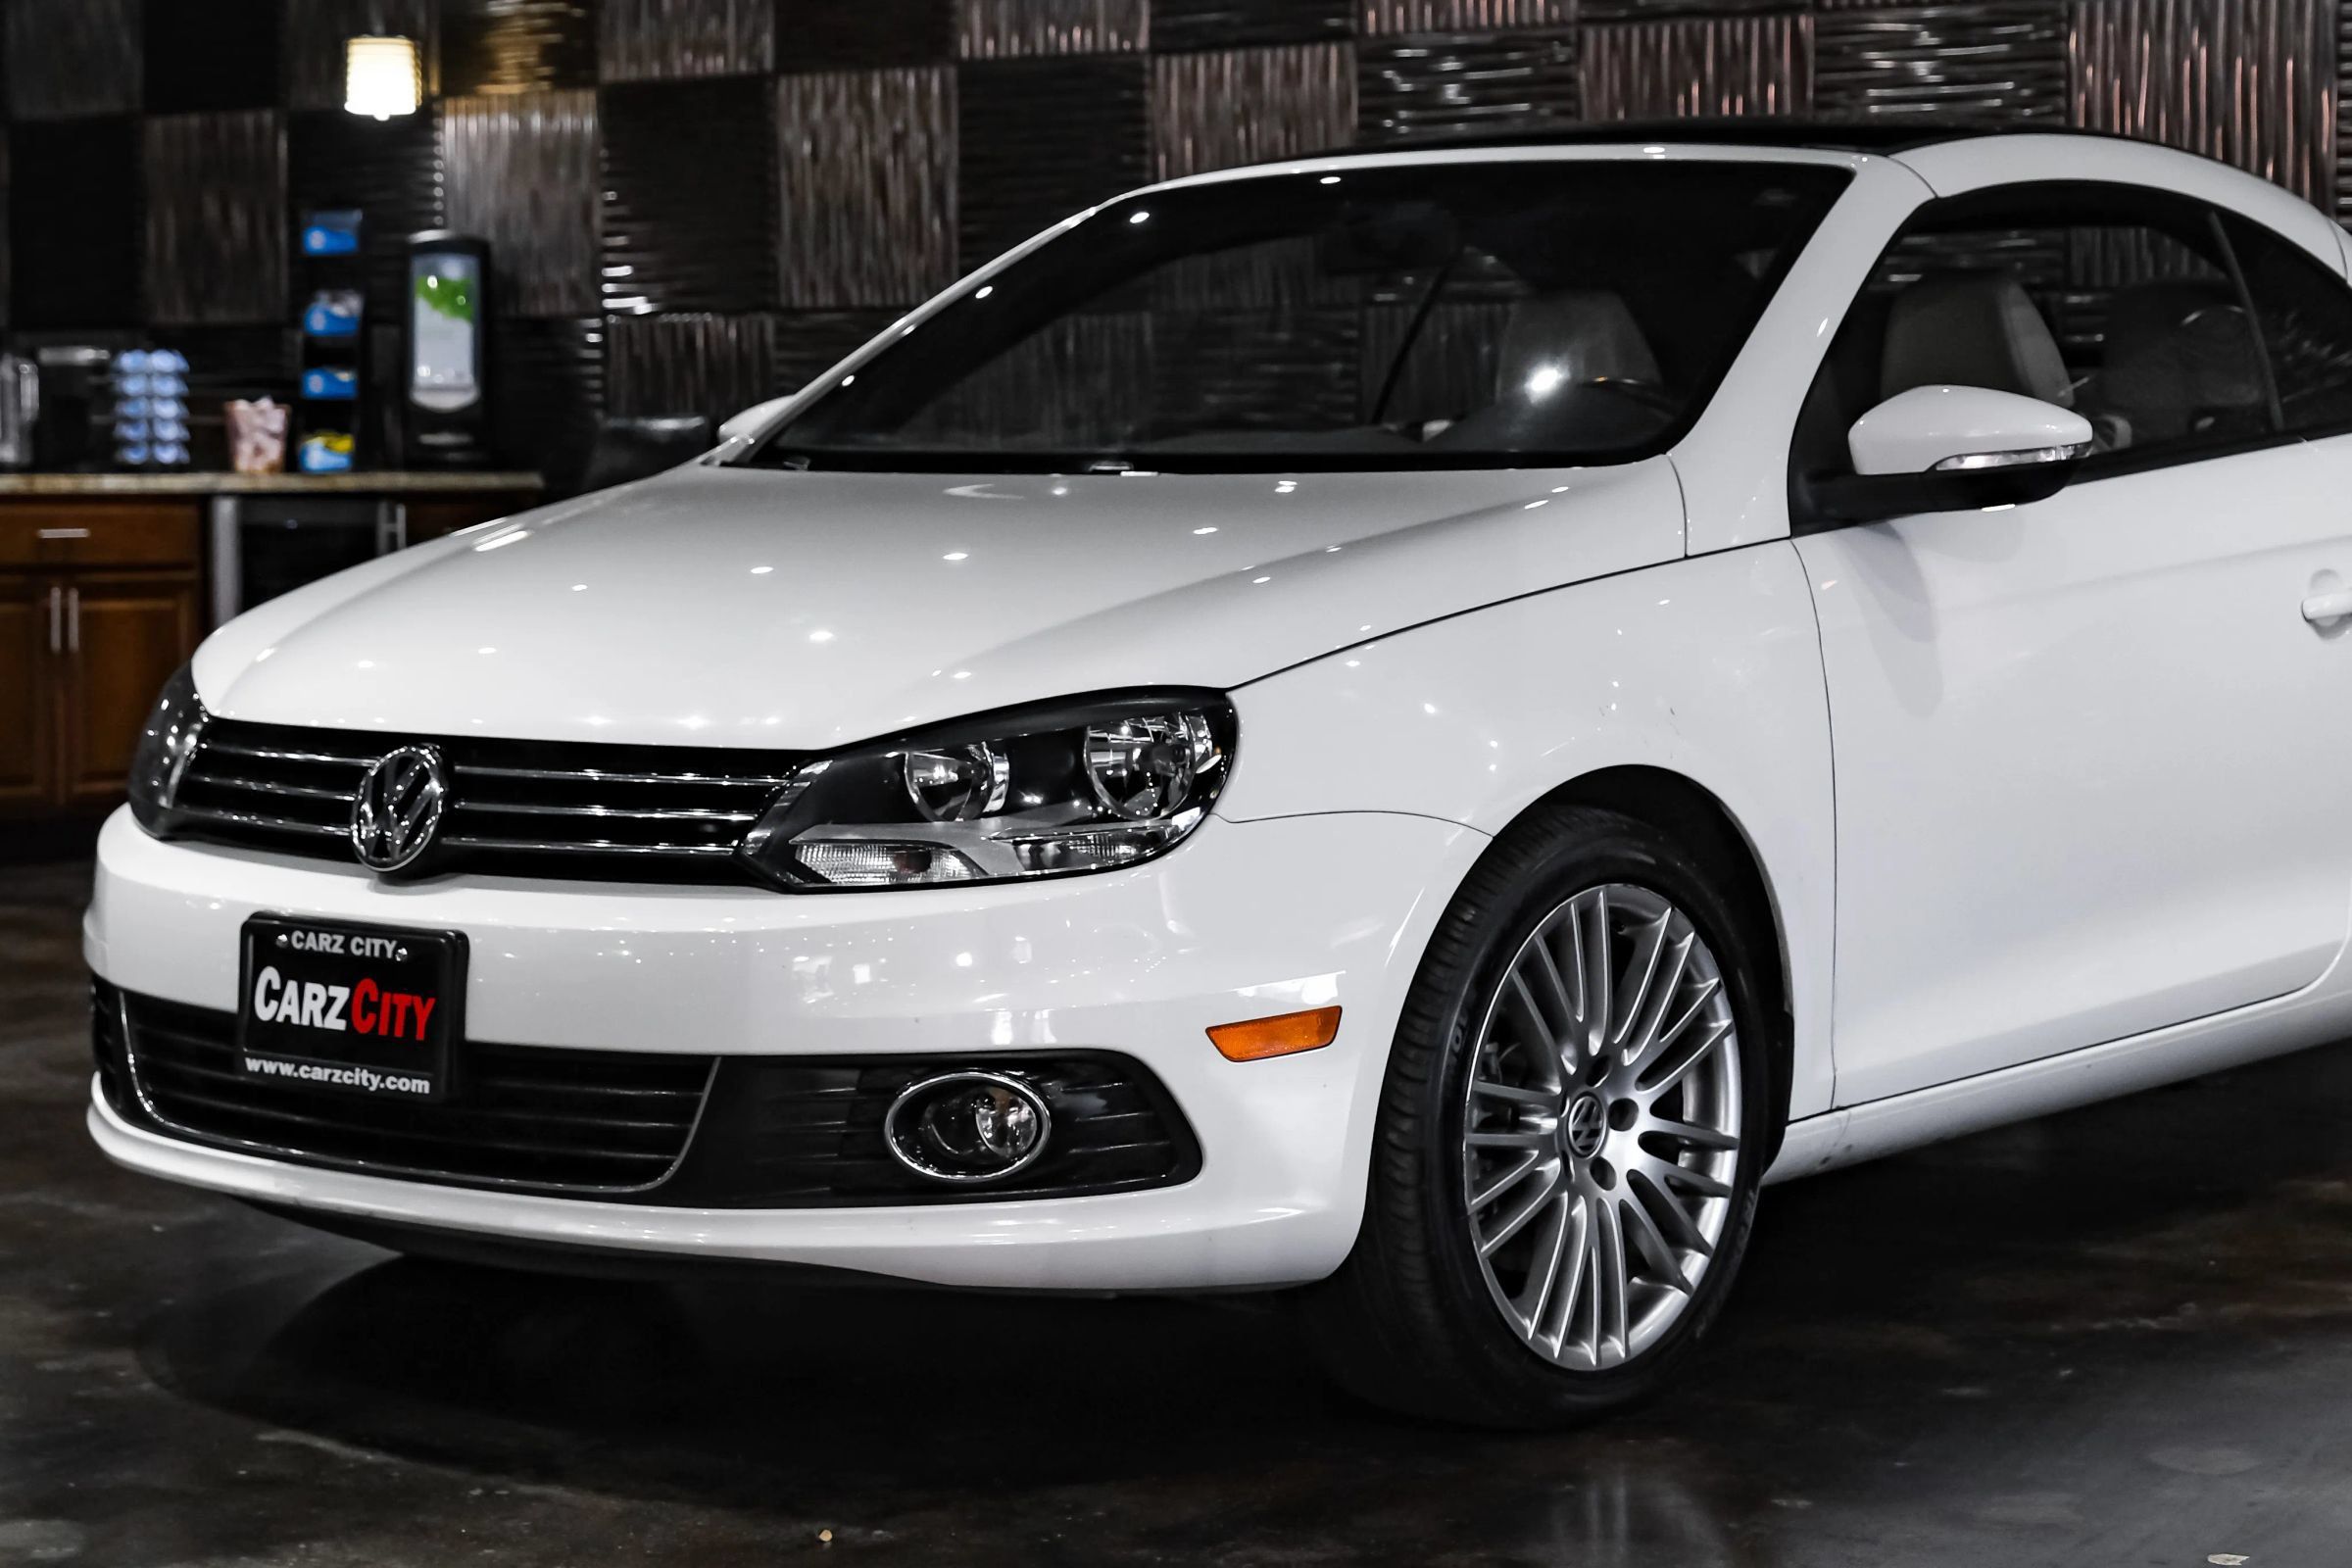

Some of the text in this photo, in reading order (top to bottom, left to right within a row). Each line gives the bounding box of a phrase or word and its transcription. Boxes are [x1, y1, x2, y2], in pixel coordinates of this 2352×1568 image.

[290, 930, 398, 959] CARZ CITY
[245, 1056, 431, 1095] www.carzcity.com
